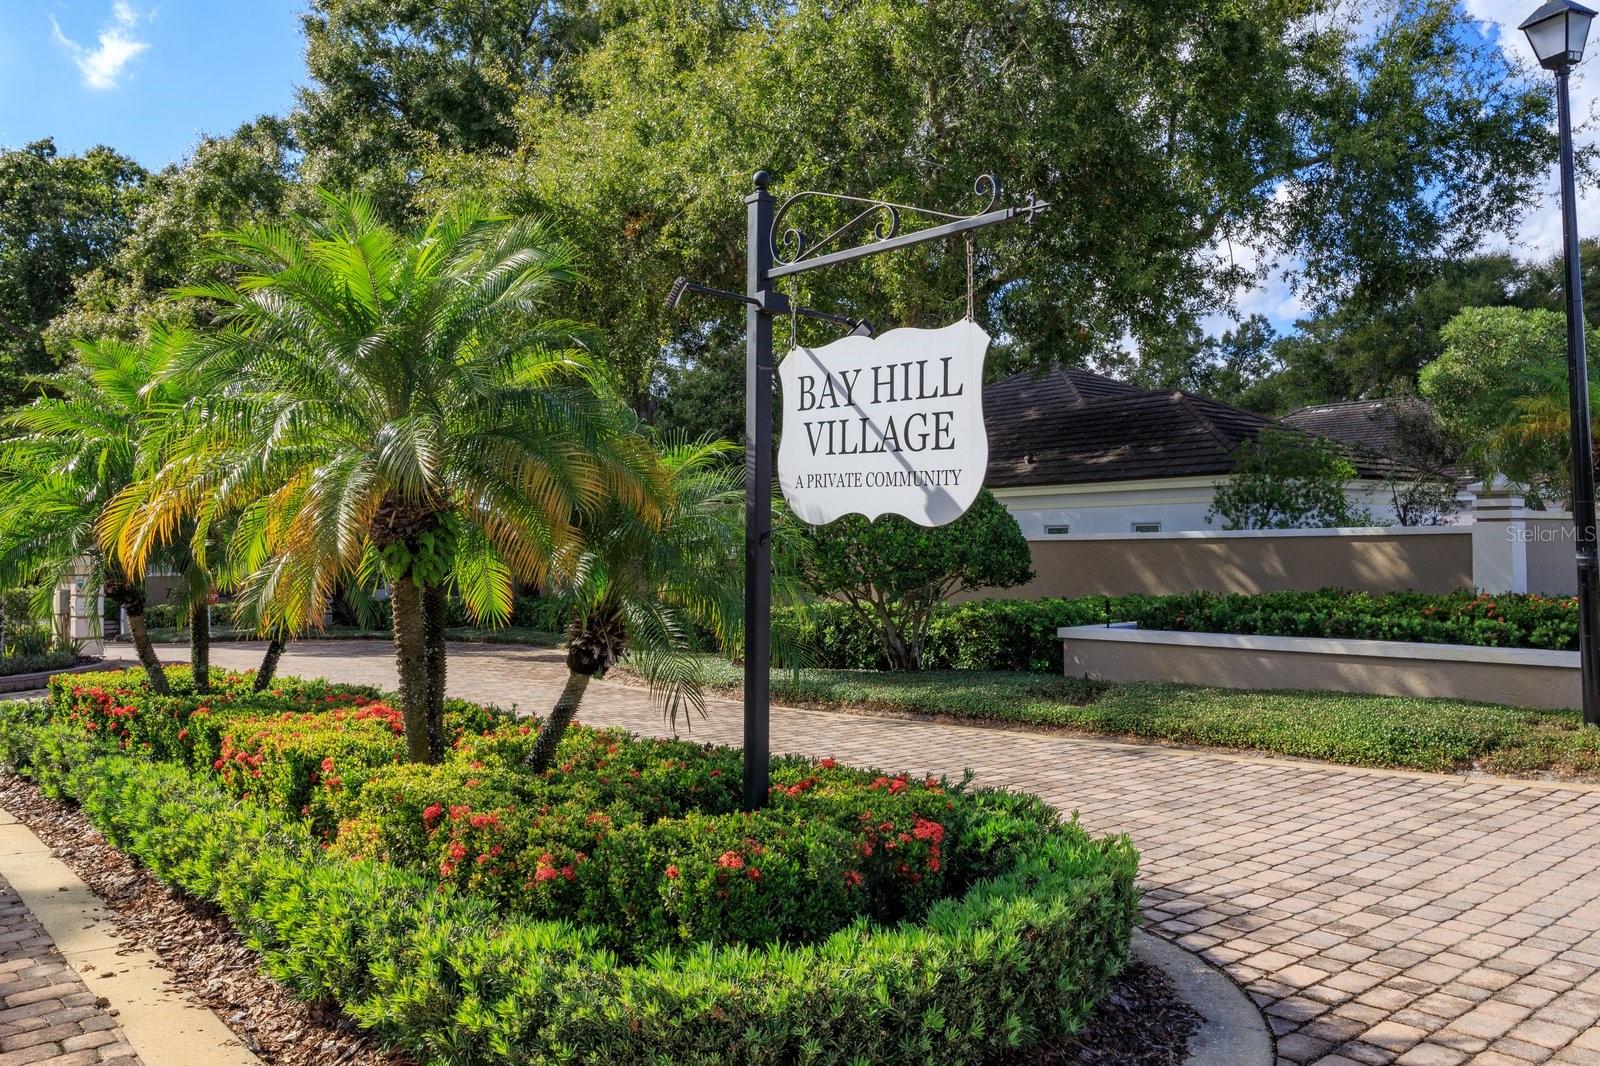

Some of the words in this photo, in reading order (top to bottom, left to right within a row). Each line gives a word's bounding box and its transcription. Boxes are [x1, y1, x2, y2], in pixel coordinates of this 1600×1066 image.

[797, 368, 862, 411] BAY
[870, 356, 963, 404] HILL
[803, 411, 955, 456] VILLAGE
[795, 475, 804, 489] A
[807, 472, 863, 488] PRIVATE
[865, 469, 962, 488] COMMUNITY
